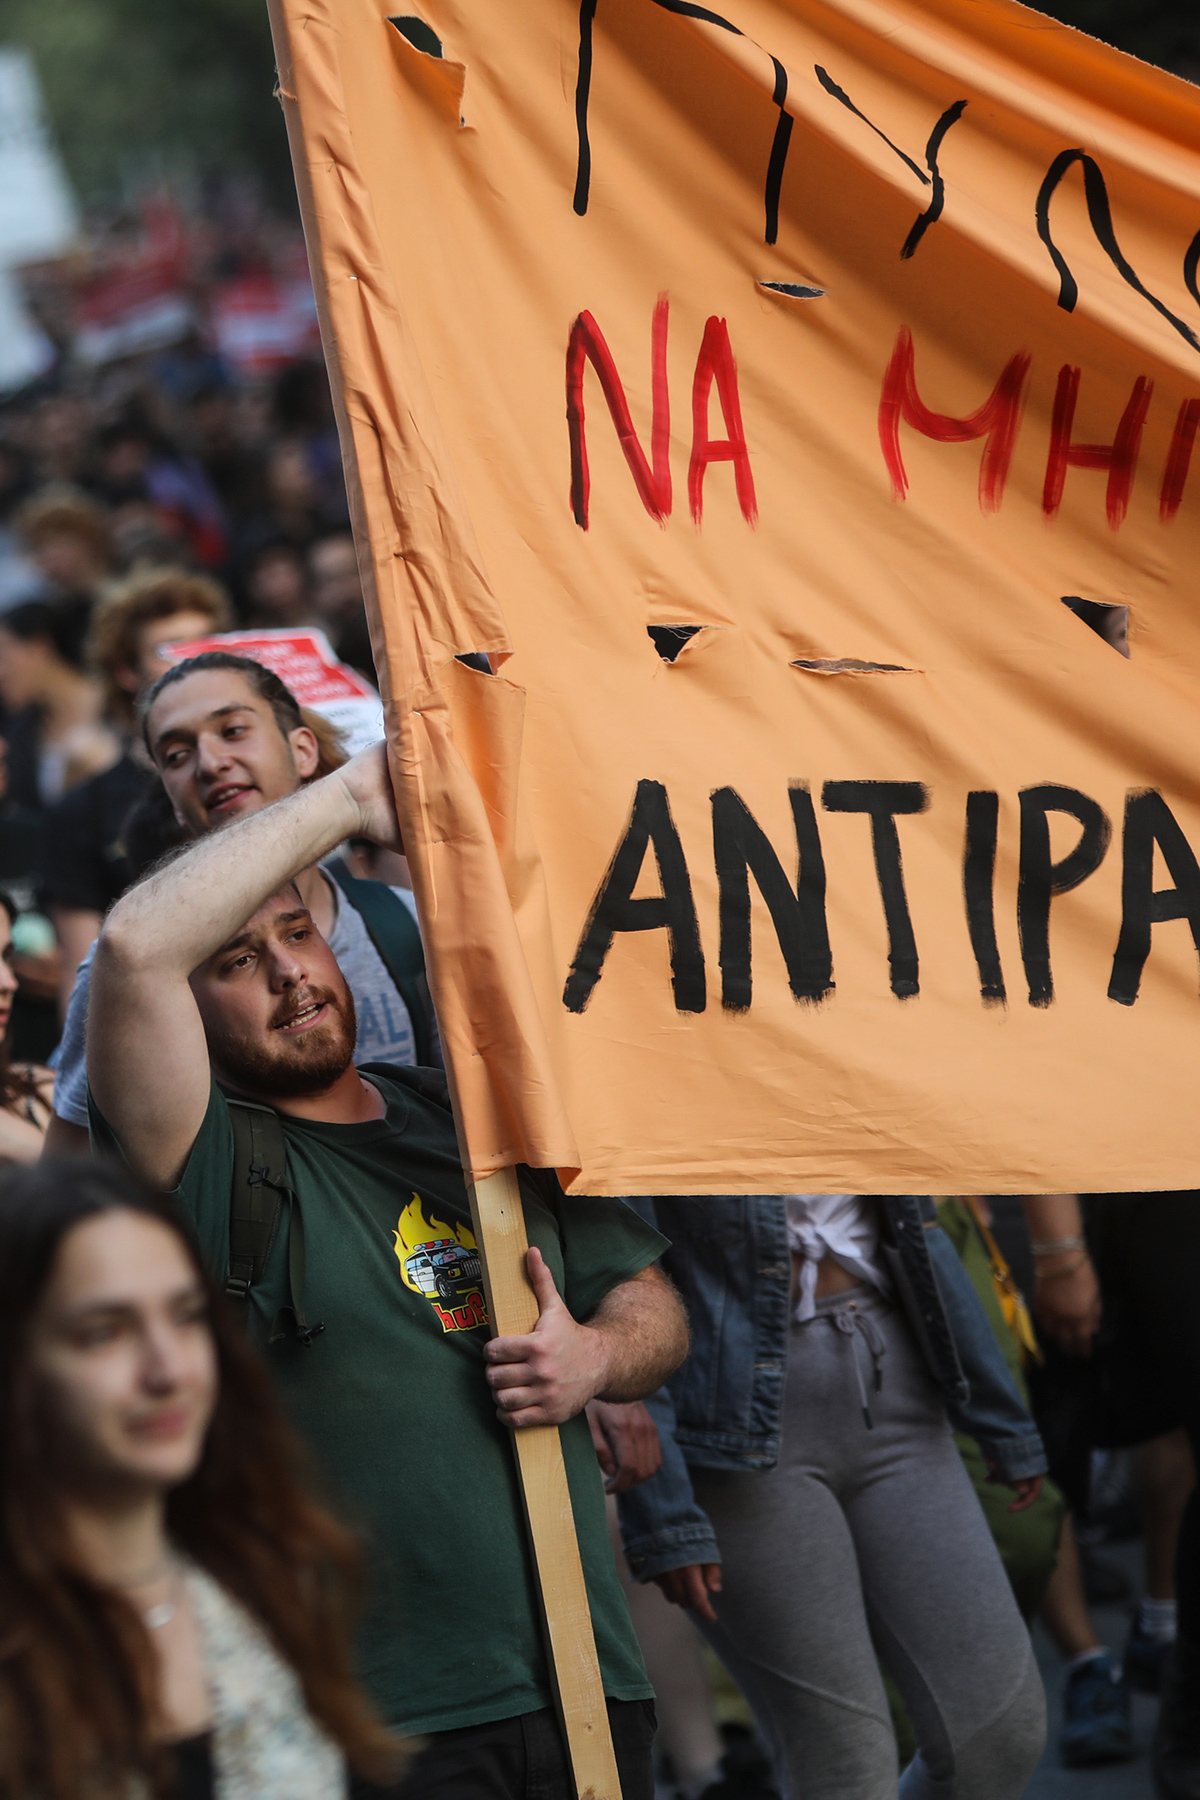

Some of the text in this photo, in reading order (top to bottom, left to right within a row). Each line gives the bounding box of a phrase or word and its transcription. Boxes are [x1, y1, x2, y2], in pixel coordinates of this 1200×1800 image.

[573, 0, 1200, 353] ΠΥΛ
[566, 292, 758, 532] ΝΑ
[562, 778, 1200, 1016] ΑΝΤΙΡΑ
[431, 1291, 490, 1333] huf
